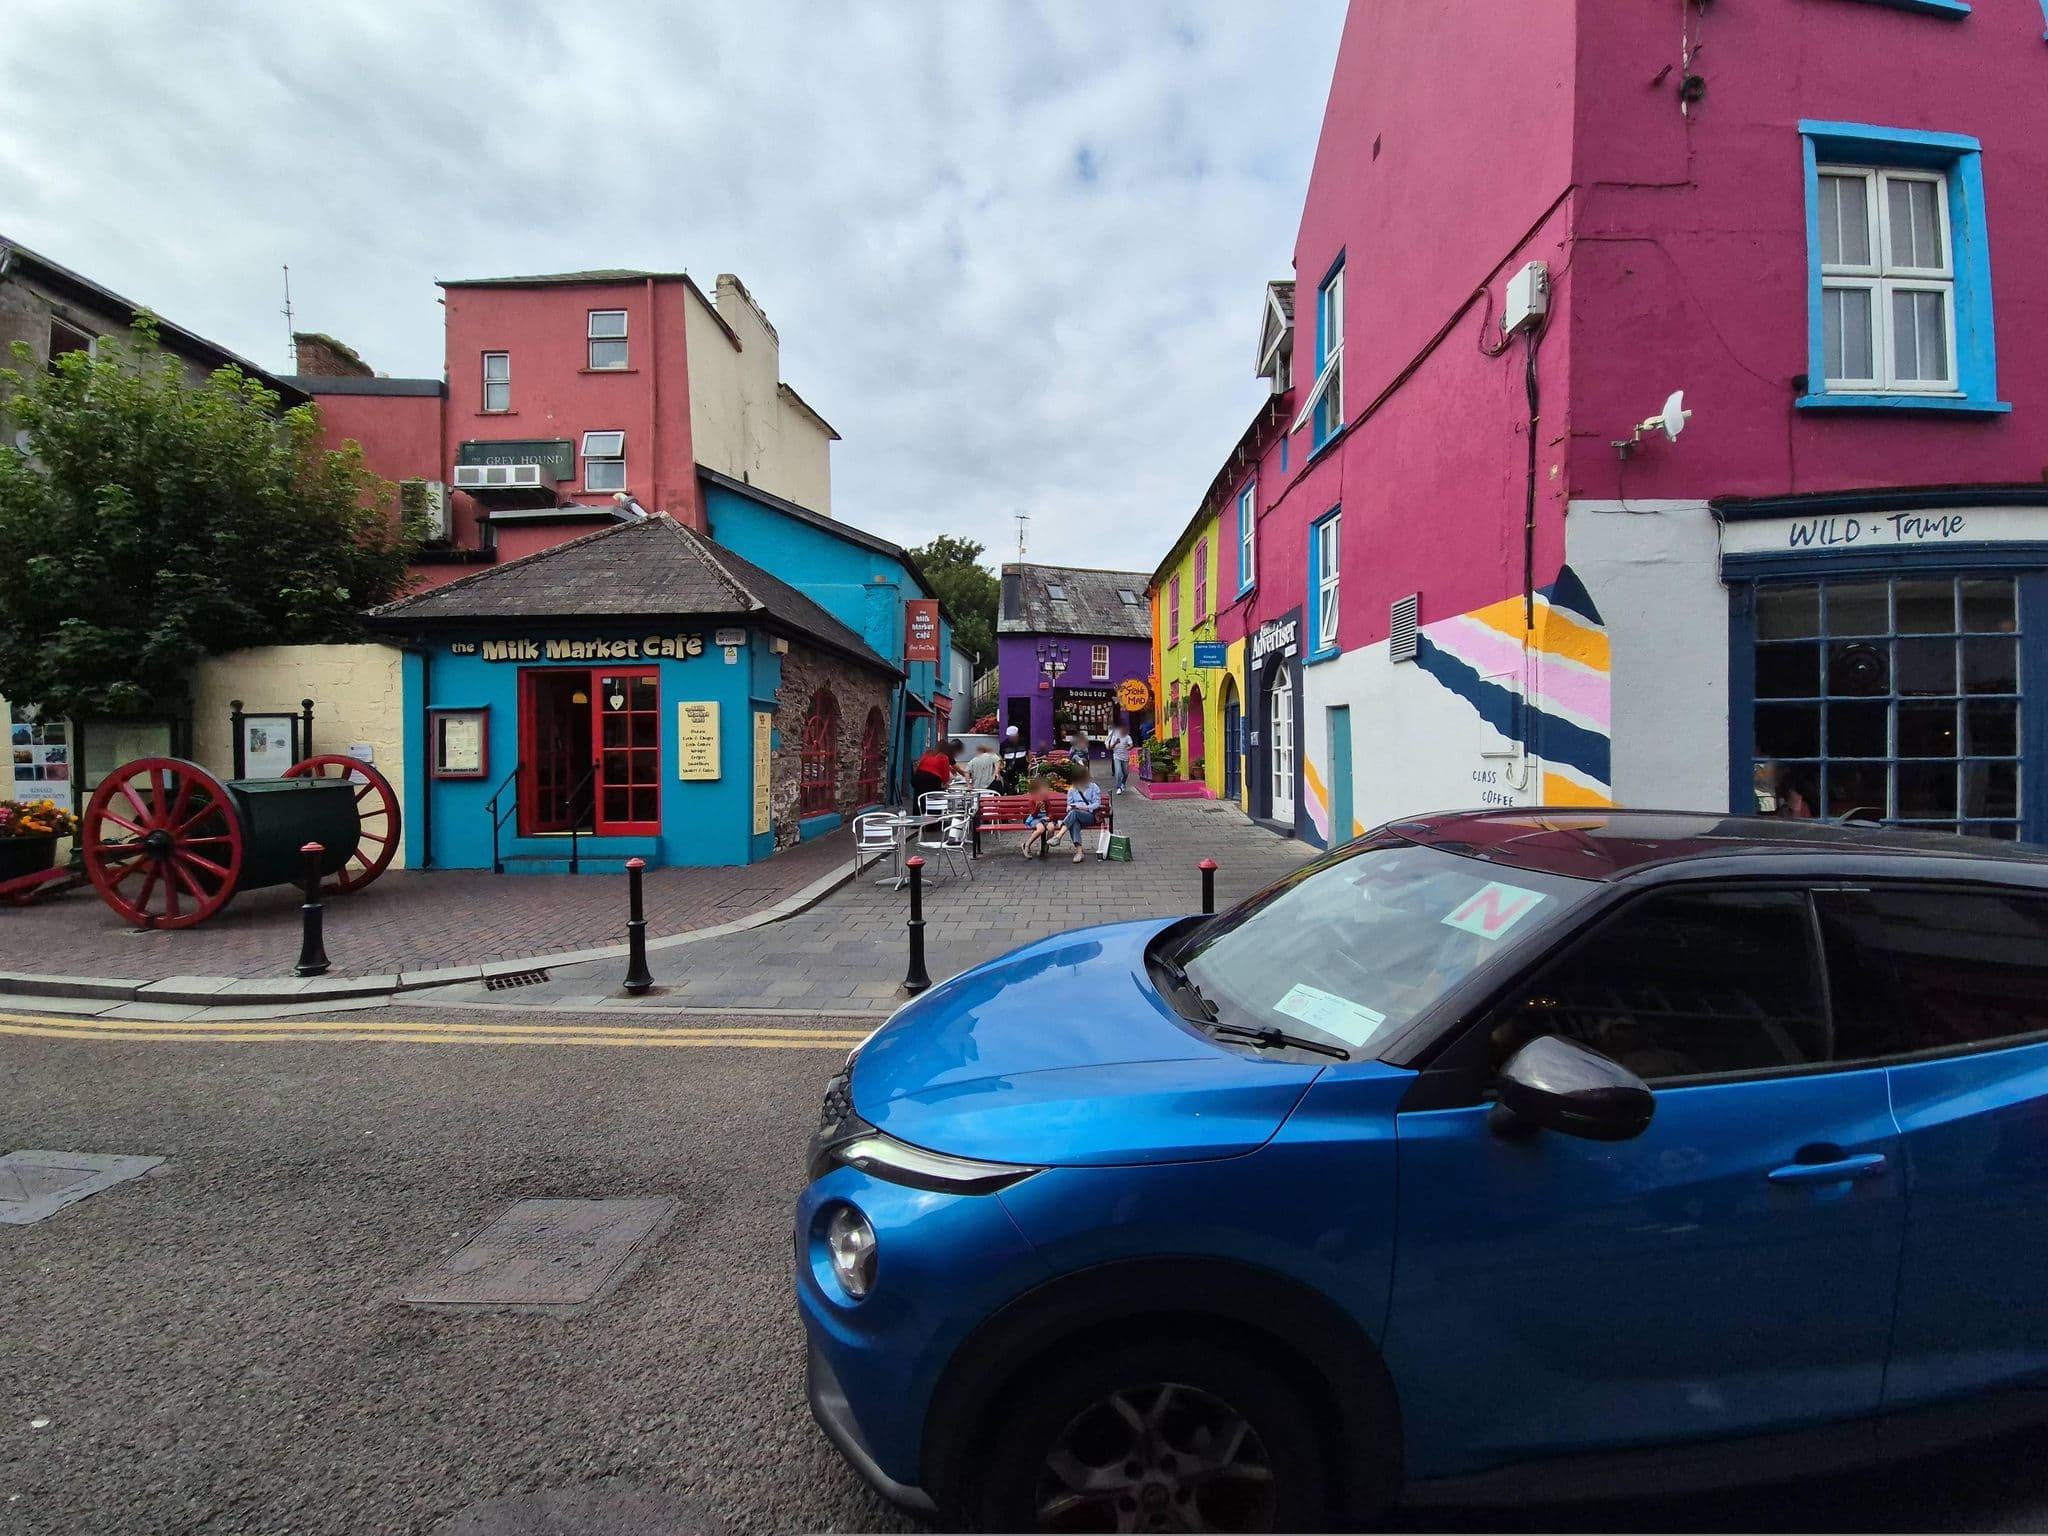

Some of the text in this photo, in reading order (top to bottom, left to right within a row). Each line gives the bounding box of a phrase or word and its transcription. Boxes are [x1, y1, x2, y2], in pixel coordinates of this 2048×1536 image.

[486, 456, 515, 465] GREY
[521, 455, 563, 465] HOUND
[1789, 513, 1966, 547] WILD + Tame
[452, 642, 475, 653] the
[482, 638, 540, 660] Milk
[546, 637, 640, 659] Market
[643, 633, 702, 659] Café
[1252, 620, 1297, 660] Advertiser
[1472, 771, 1497, 784] CLASS
[1482, 791, 1513, 806] COFFEE
[1453, 887, 1531, 931] N
